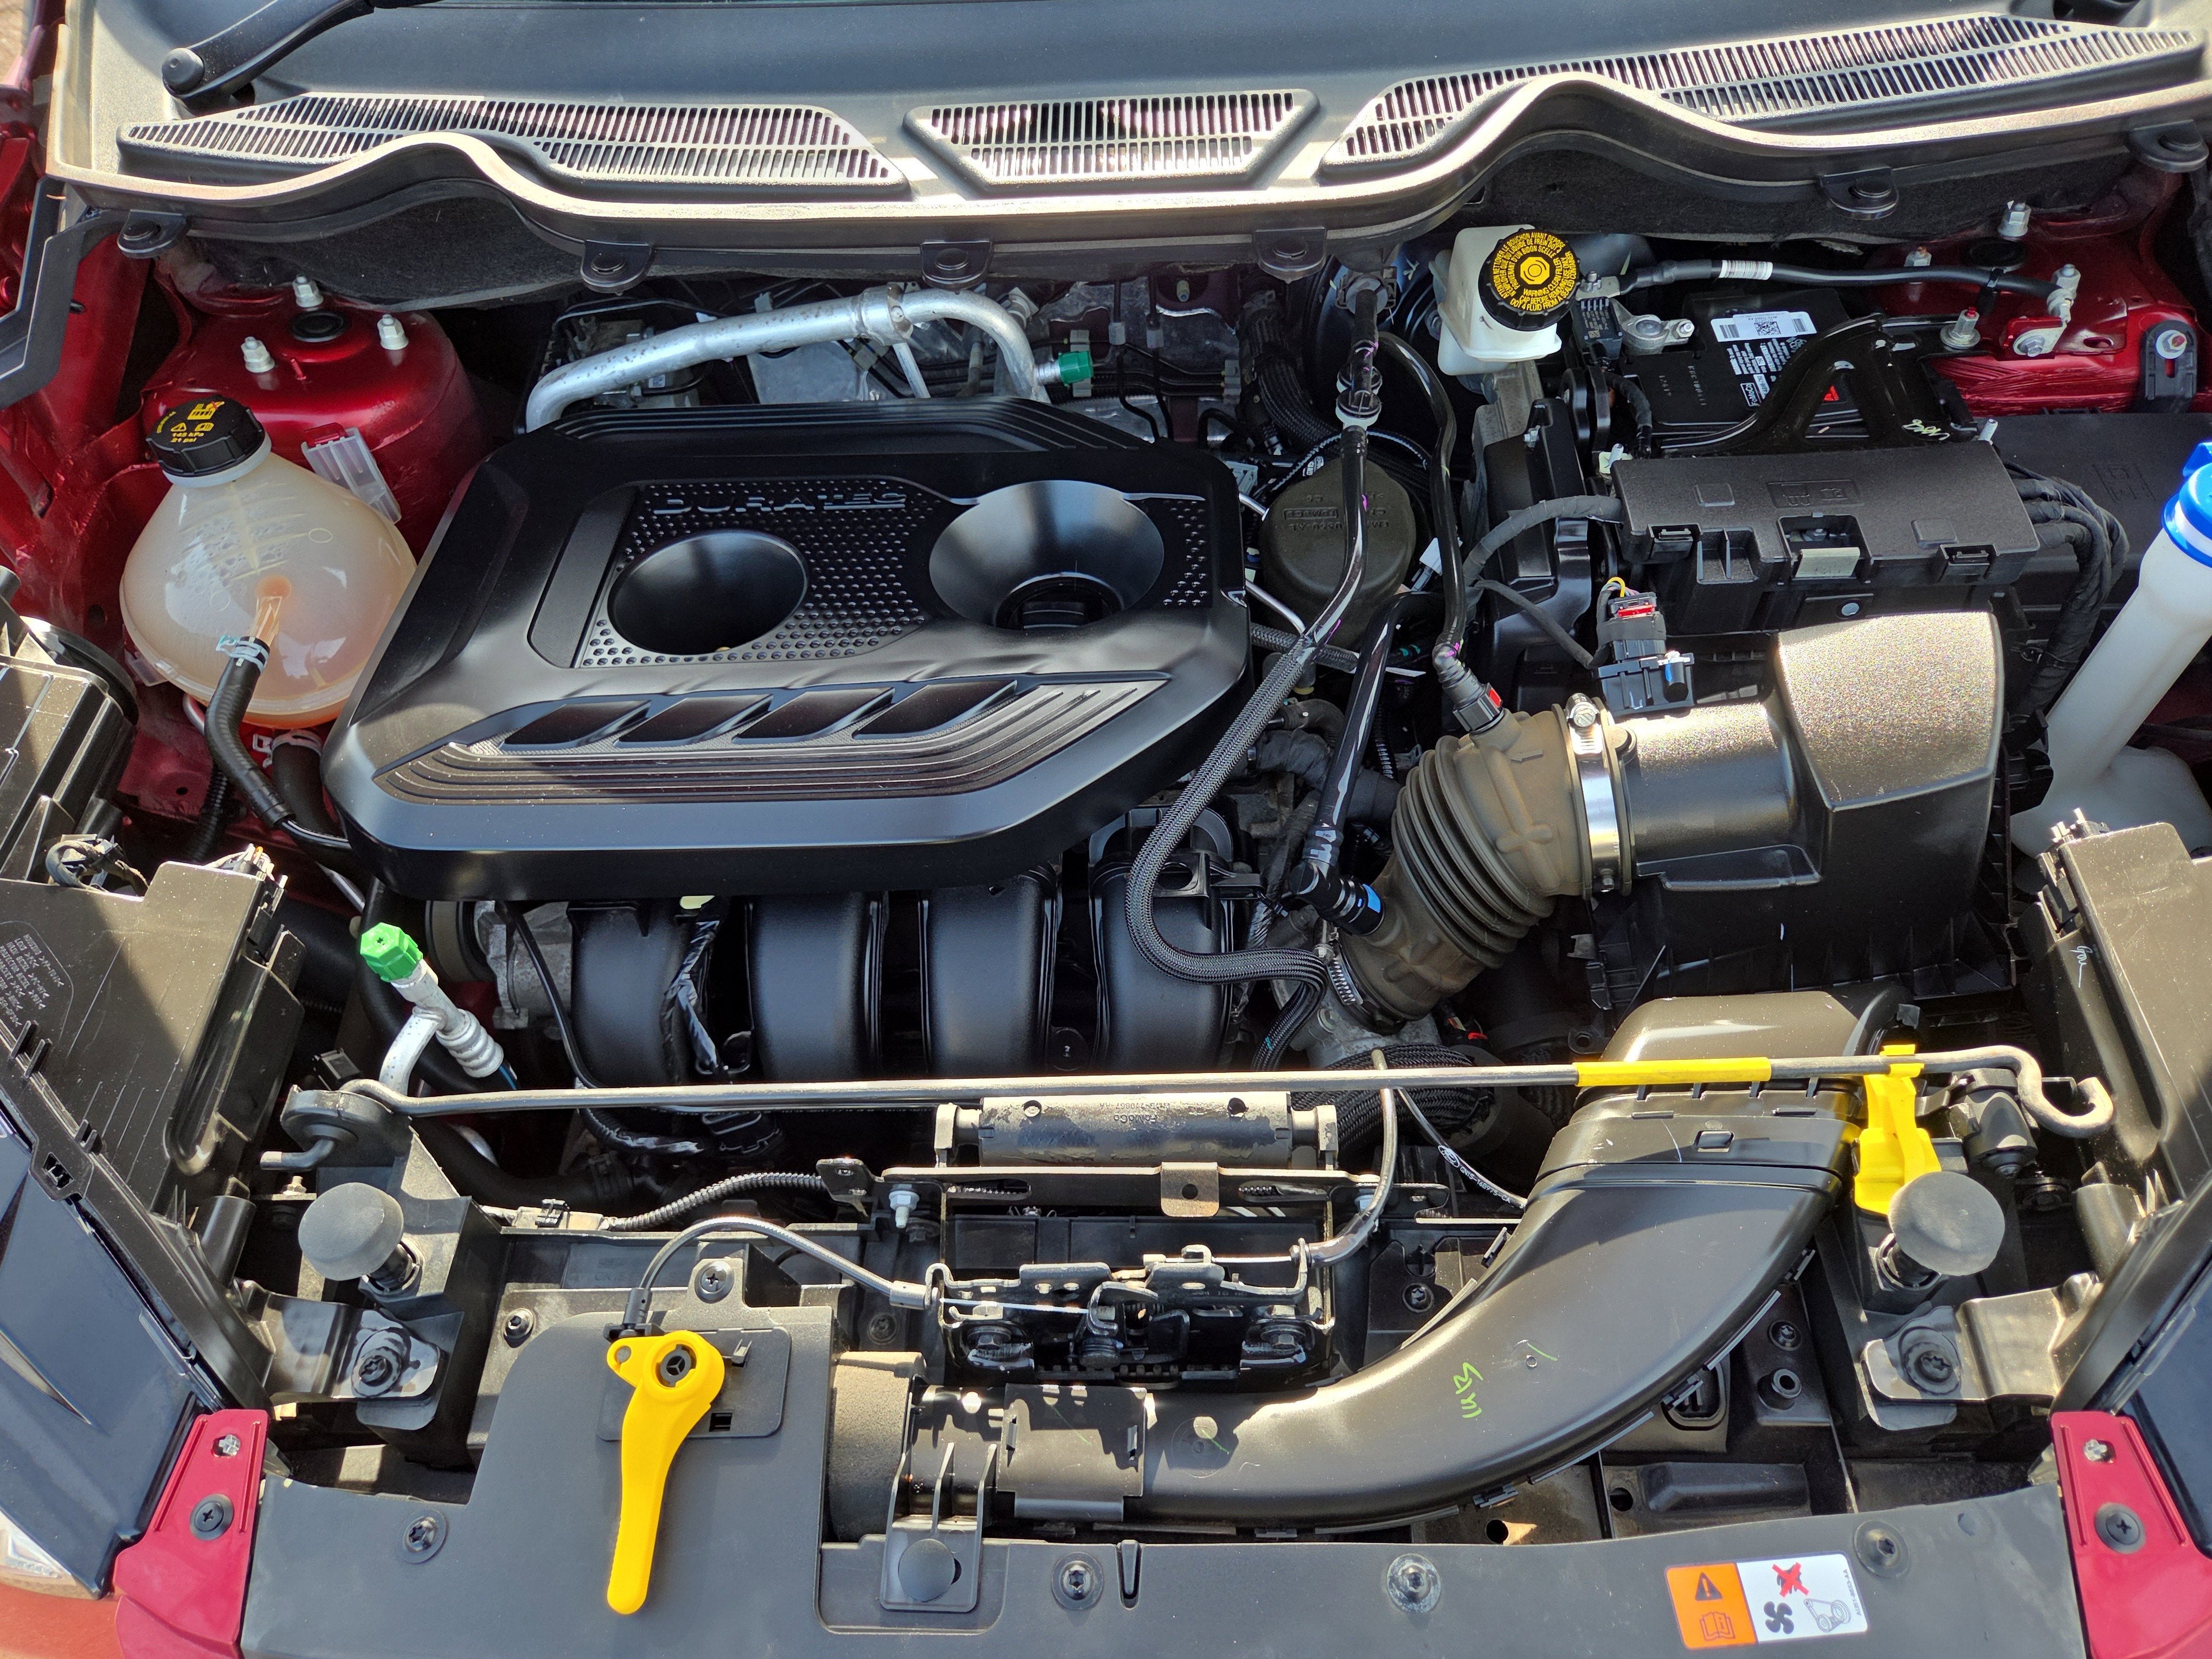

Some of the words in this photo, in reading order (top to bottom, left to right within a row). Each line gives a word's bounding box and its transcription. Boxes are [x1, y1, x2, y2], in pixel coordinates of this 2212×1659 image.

[1553, 258, 1564, 275] FILLER
[1565, 251, 1576, 279] CONTAINER
[1519, 295, 1530, 303] CAP
[1530, 295, 1551, 304] BEFORE
[1548, 278, 1569, 301] REMOVING
[1561, 255, 1570, 268] ONLY
[1548, 274, 1561, 292] CLEAN
[1560, 279, 1574, 298] SEALED
[1523, 287, 1551, 298] WARNING
[1510, 298, 1523, 307] DOT
[1543, 298, 1558, 309] FROM
[23, 935, 42, 955] HOUSING
